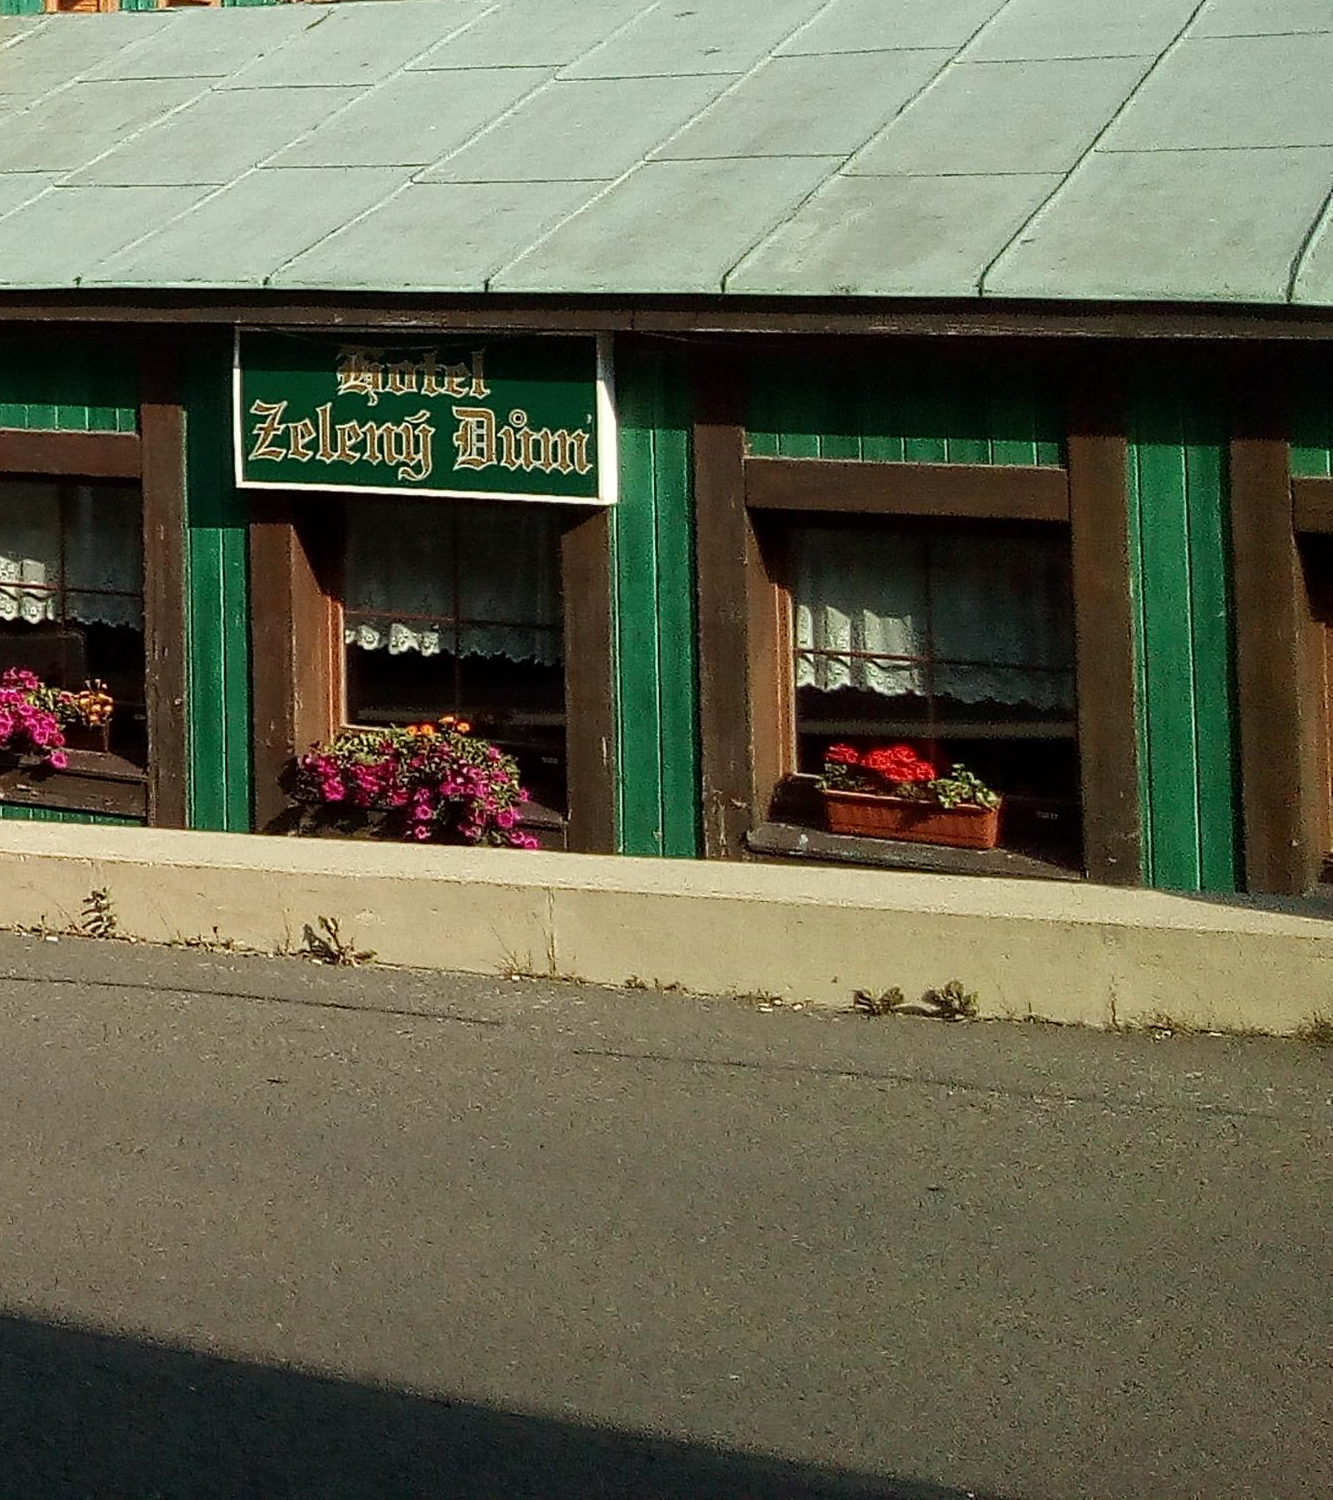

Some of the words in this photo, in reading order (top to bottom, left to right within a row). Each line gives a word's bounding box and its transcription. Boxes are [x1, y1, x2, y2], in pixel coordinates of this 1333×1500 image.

[335, 347, 491, 406] Hotel
[248, 399, 434, 481] Zelený
[452, 405, 593, 475] Dům
